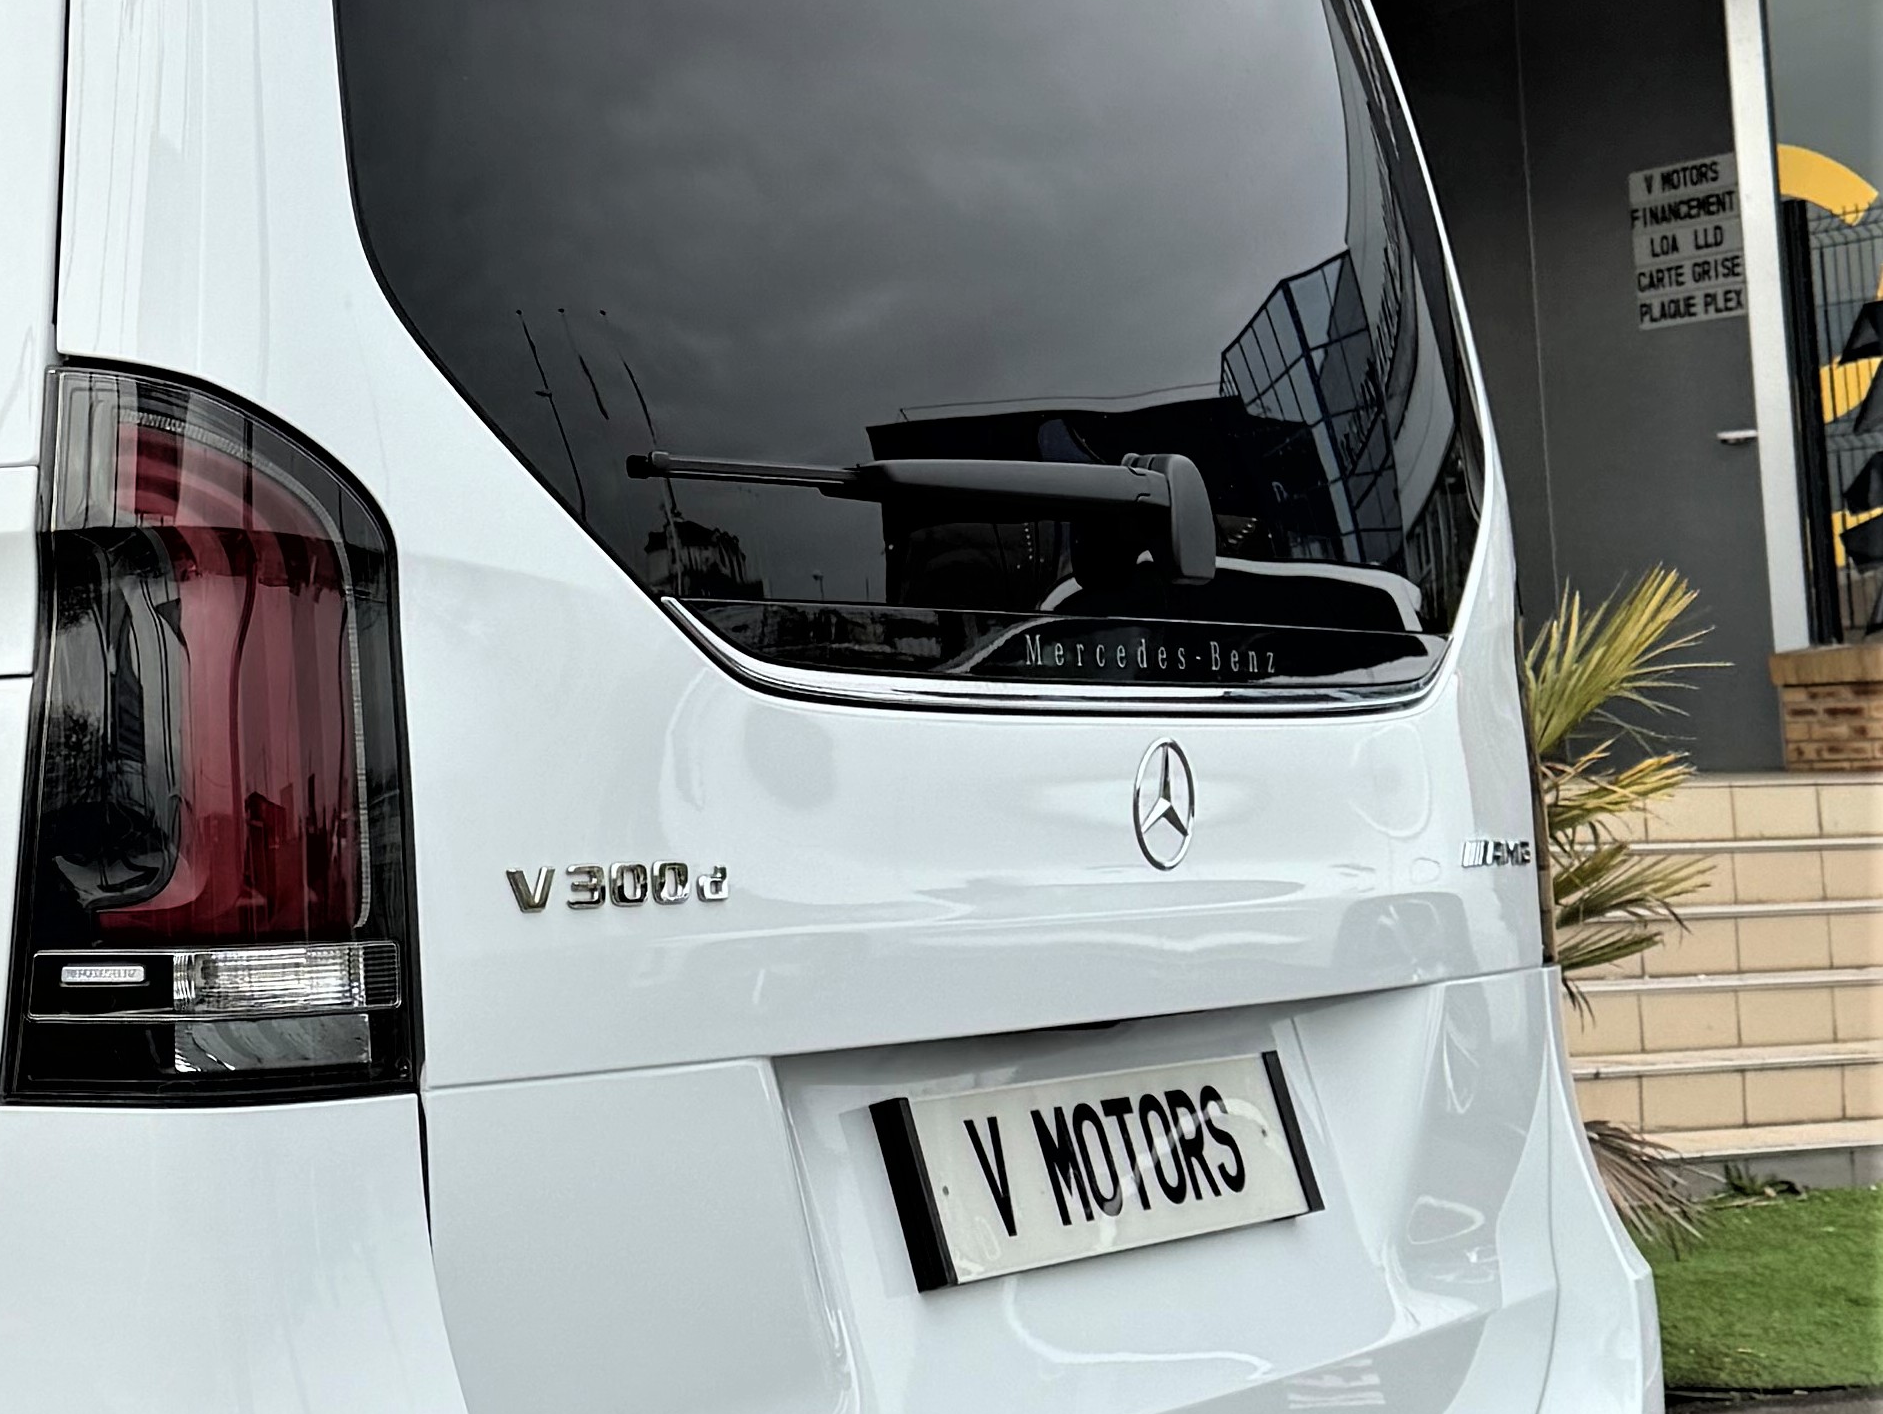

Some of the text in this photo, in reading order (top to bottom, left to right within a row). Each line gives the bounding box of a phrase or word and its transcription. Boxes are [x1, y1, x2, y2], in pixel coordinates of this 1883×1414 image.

[1644, 161, 1720, 194] V MOTORS
[1630, 190, 1736, 231] FINANCEMENT
[1650, 225, 1724, 259] LOA LLD
[1637, 255, 1742, 293] CARTE GRISE
[1639, 289, 1745, 325] PLAQUE PLEX
[1024, 633, 1277, 675] Mercedes-Benz
[963, 1085, 1246, 1237] V MOTORS
